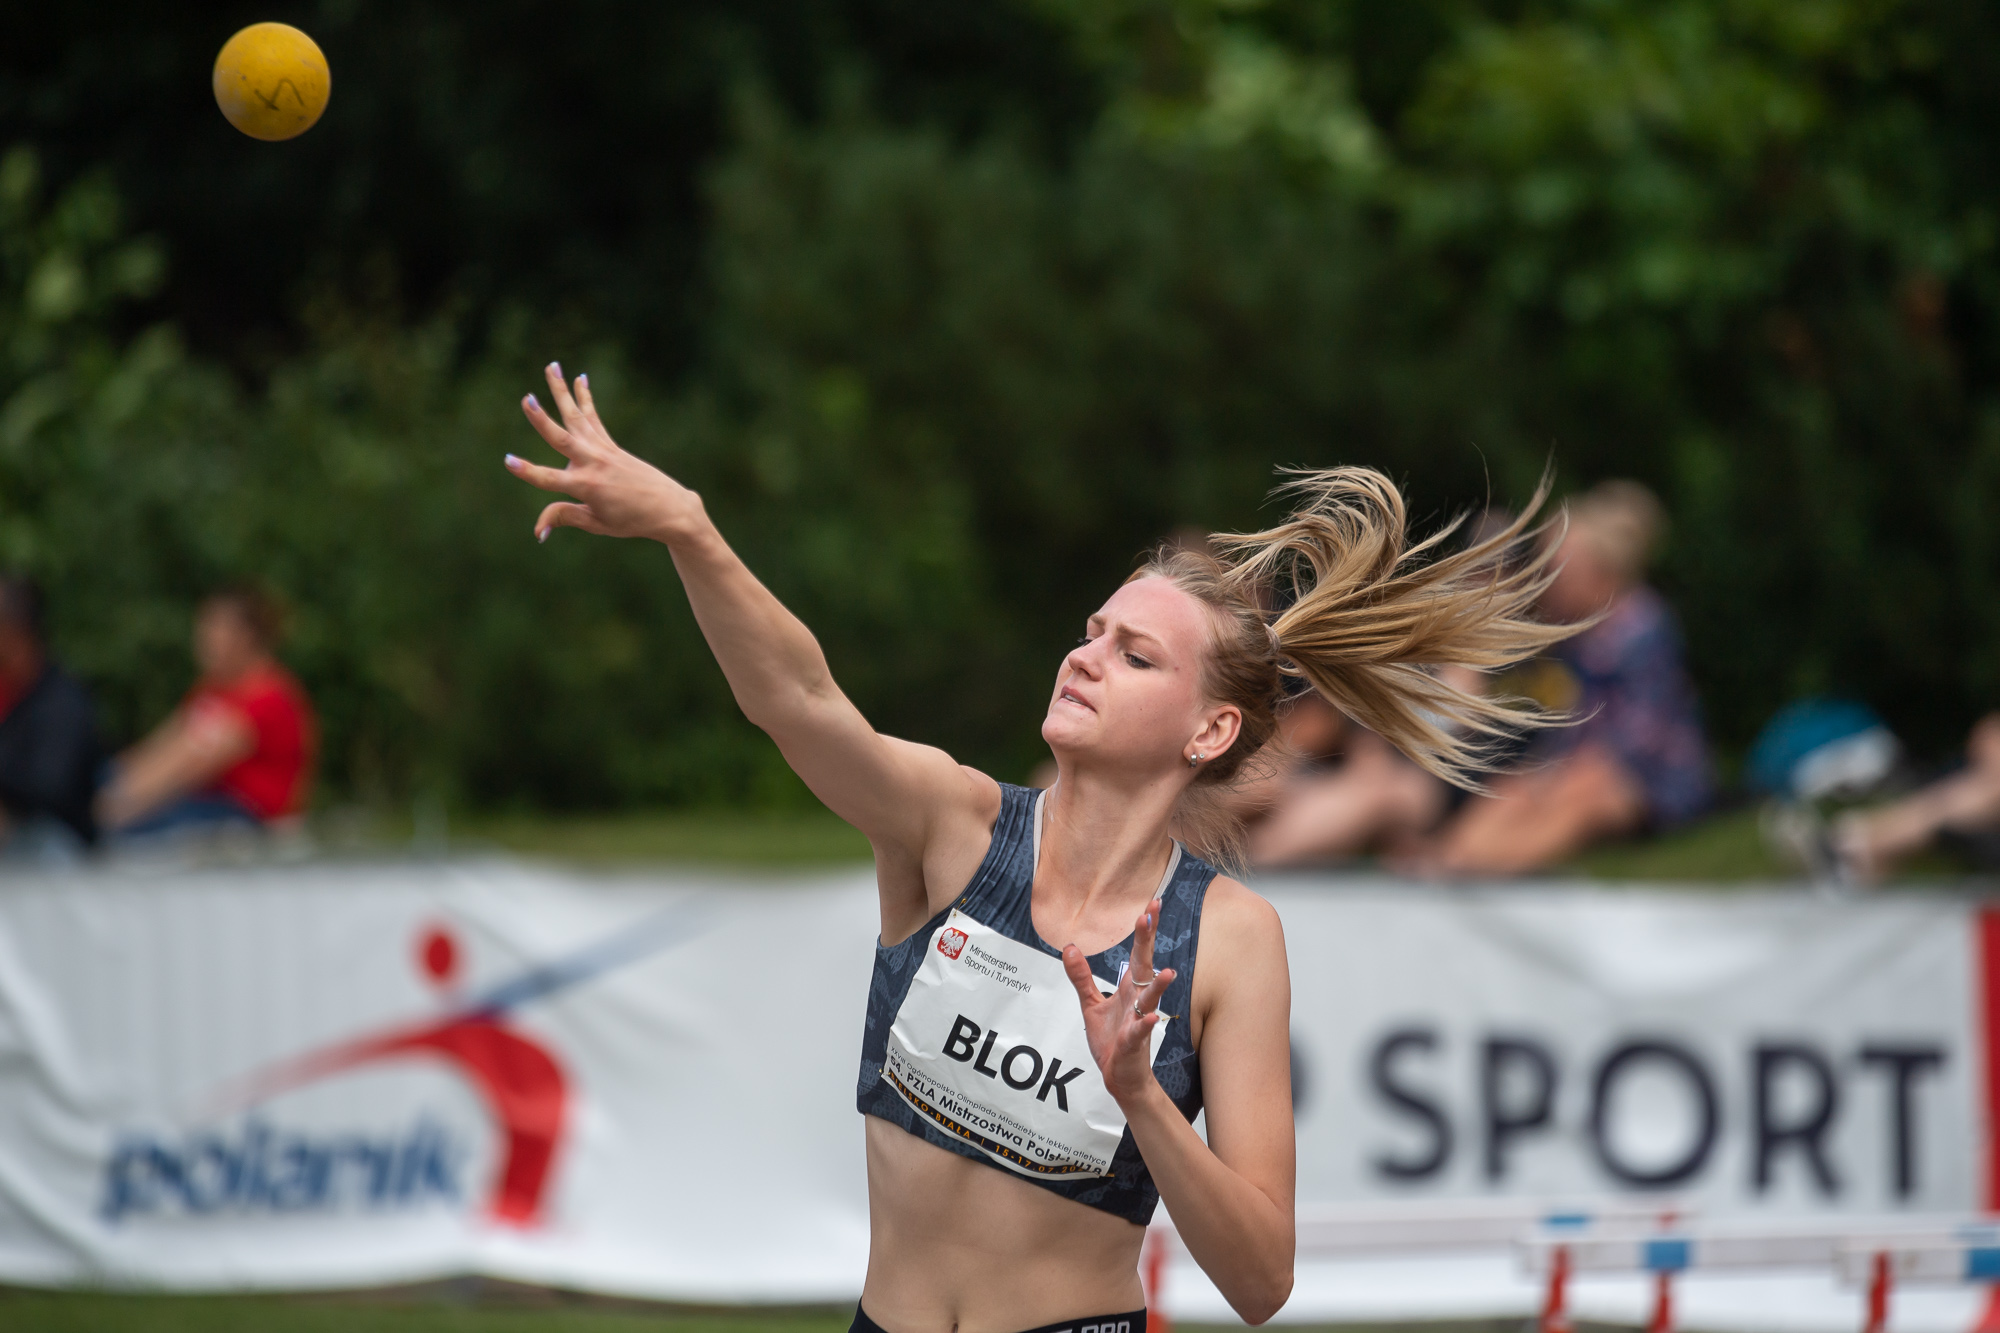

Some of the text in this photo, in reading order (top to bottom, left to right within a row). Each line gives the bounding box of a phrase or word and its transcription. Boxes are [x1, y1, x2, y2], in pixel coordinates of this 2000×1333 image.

[964, 955, 991, 976] Sportu
[995, 971, 1032, 993] Turystyki
[969, 944, 1018, 974] Ministerstwo
[889, 1055, 904, 1077] 54.
[906, 1072, 936, 1102] PZLA
[938, 1095, 1023, 1147] Mistrzostwa
[941, 1013, 1085, 1114] BLOK
[1368, 1022, 1946, 1198] SPORT
[888, 1071, 1085, 1174] BIELSKO-BIAŁA 15-17.07.20
[906, 1062, 956, 1096] Ogólnopolska
[956, 1093, 998, 1118] Olimpiada
[998, 1114, 1037, 1138] Młodzieży
[1037, 1134, 1046, 1142] w
[1046, 1137, 1072, 1155] lekkiej
[1072, 1149, 1107, 1167] atletyce
